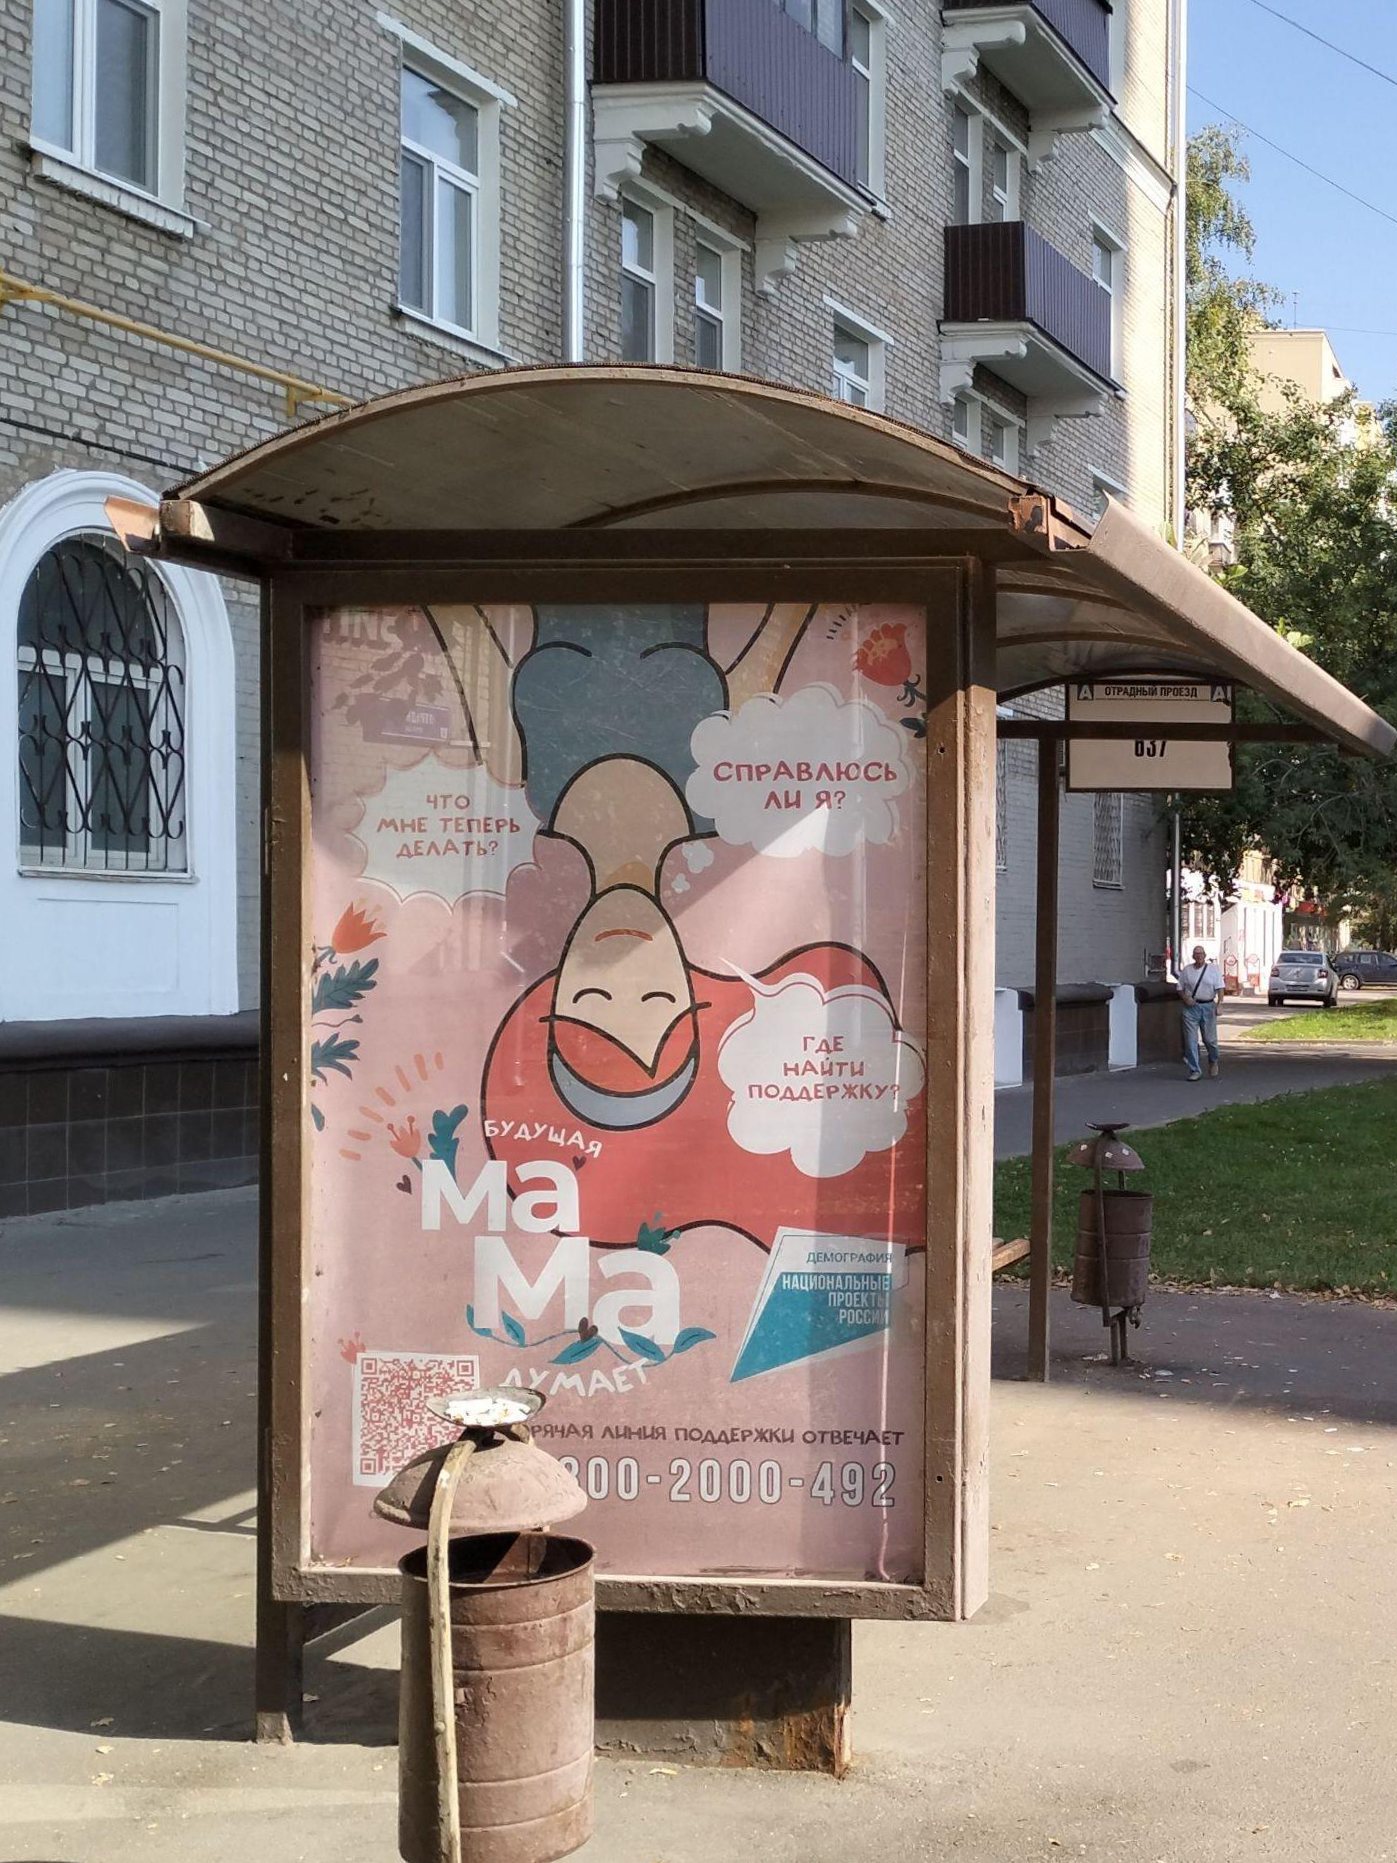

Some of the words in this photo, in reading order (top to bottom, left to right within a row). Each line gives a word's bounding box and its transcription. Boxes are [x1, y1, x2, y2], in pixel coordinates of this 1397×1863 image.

[1104, 686, 1157, 698] ОТРАДНЫЙ
[1160, 686, 1197, 698] ПРОЕЗД
[713, 760, 898, 782] СПРАВЛЮСЬ
[426, 794, 470, 809] ЧТО
[764, 790, 800, 809] ЛИ
[815, 790, 846, 809] Я?
[377, 817, 428, 833] МНЕ
[439, 817, 521, 833] ТЕПЕРЬ
[396, 838, 499, 858] ДЕЛАТЬ?
[803, 1036, 844, 1053] ГДЕ
[783, 1057, 865, 1077] НАЙТИ
[748, 1083, 900, 1102] ПОДДЕРЖКУ?
[484, 1120, 602, 1158] БУДУЩАЯ
[806, 1252, 891, 1264] ДЕМОГРАФИЯ
[783, 1274, 890, 1291] НАЦИОНАЛЬНЫЕ
[829, 1292, 889, 1308] ПРОЕКТЫ
[840, 1309, 889, 1324] РОССИИ
[524, 1423, 593, 1440] РЯЧАЯ
[601, 1425, 667, 1442] ЛИНИЯ
[674, 1426, 795, 1445] ПОДДЕРЖКИ
[802, 1430, 905, 1447] ОТВЕЧАЕТ
